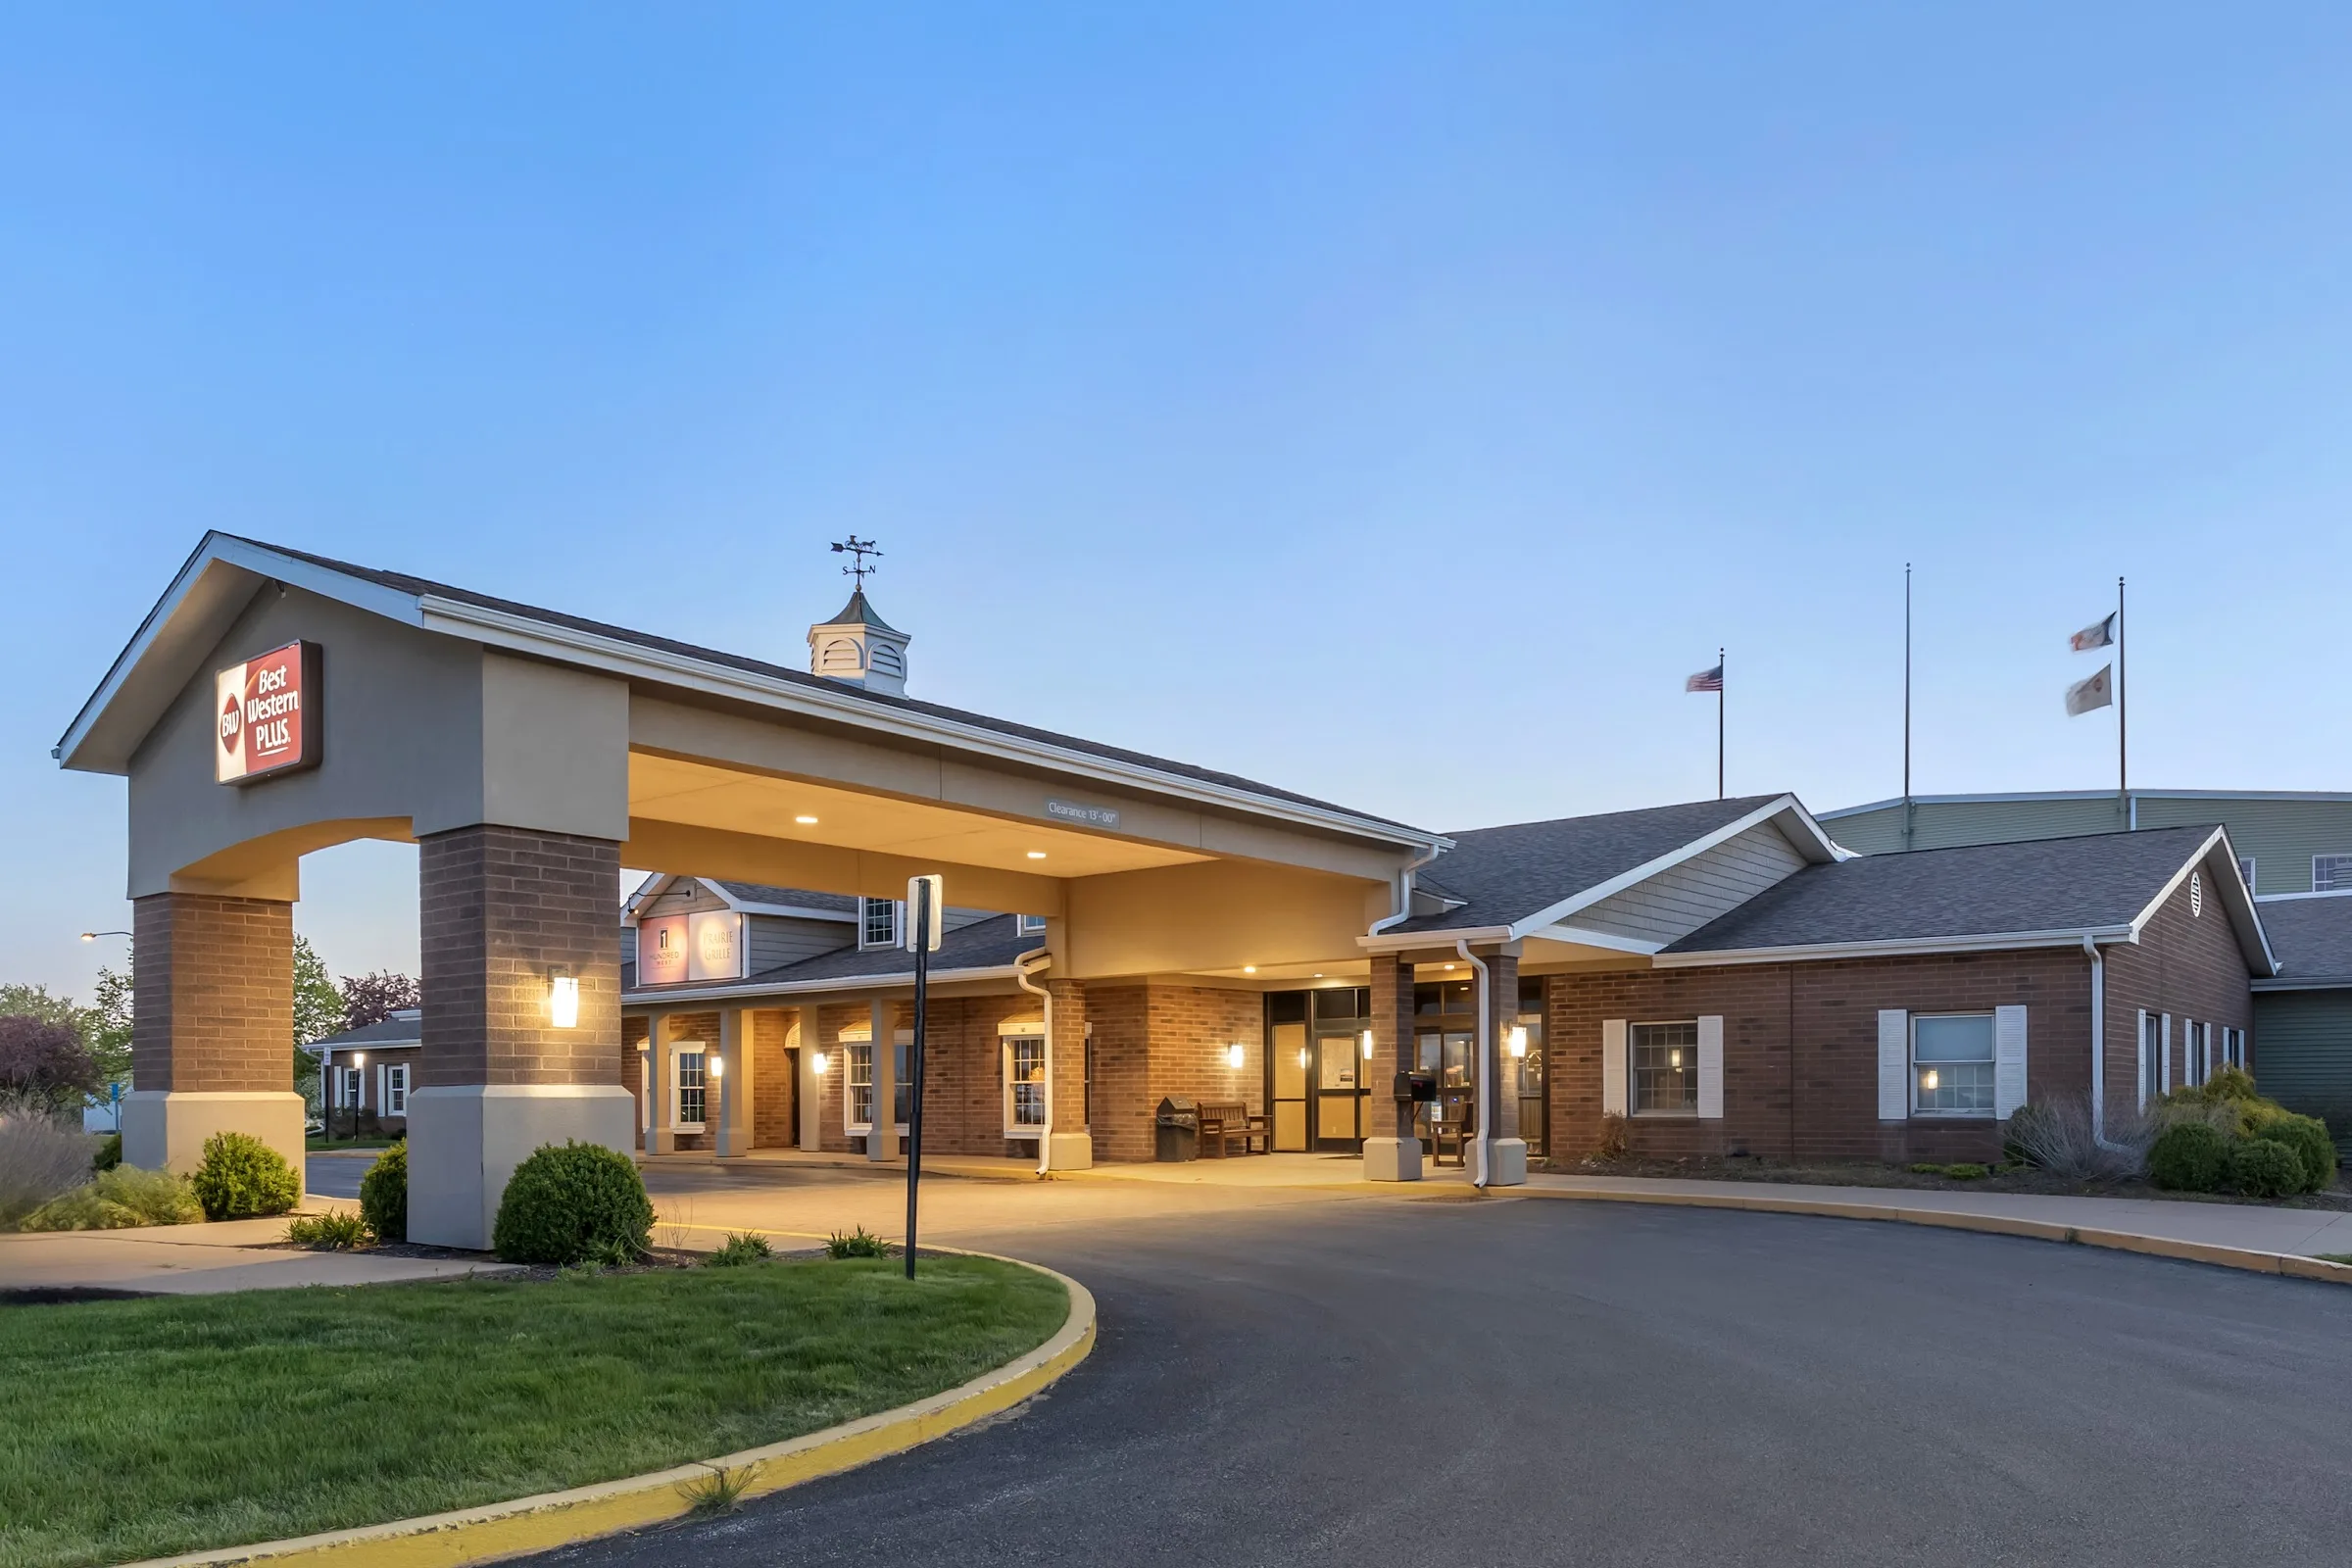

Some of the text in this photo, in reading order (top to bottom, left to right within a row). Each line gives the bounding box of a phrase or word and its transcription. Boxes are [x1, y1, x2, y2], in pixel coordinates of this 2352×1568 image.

[258, 664, 287, 695] Best
[247, 690, 299, 724] Western
[221, 710, 239, 738] BW
[1049, 802, 1087, 818] Clearance
[703, 930, 734, 946] PRAIRIE
[649, 951, 680, 960] HUNDRED
[705, 948, 731, 960] GRILLE
